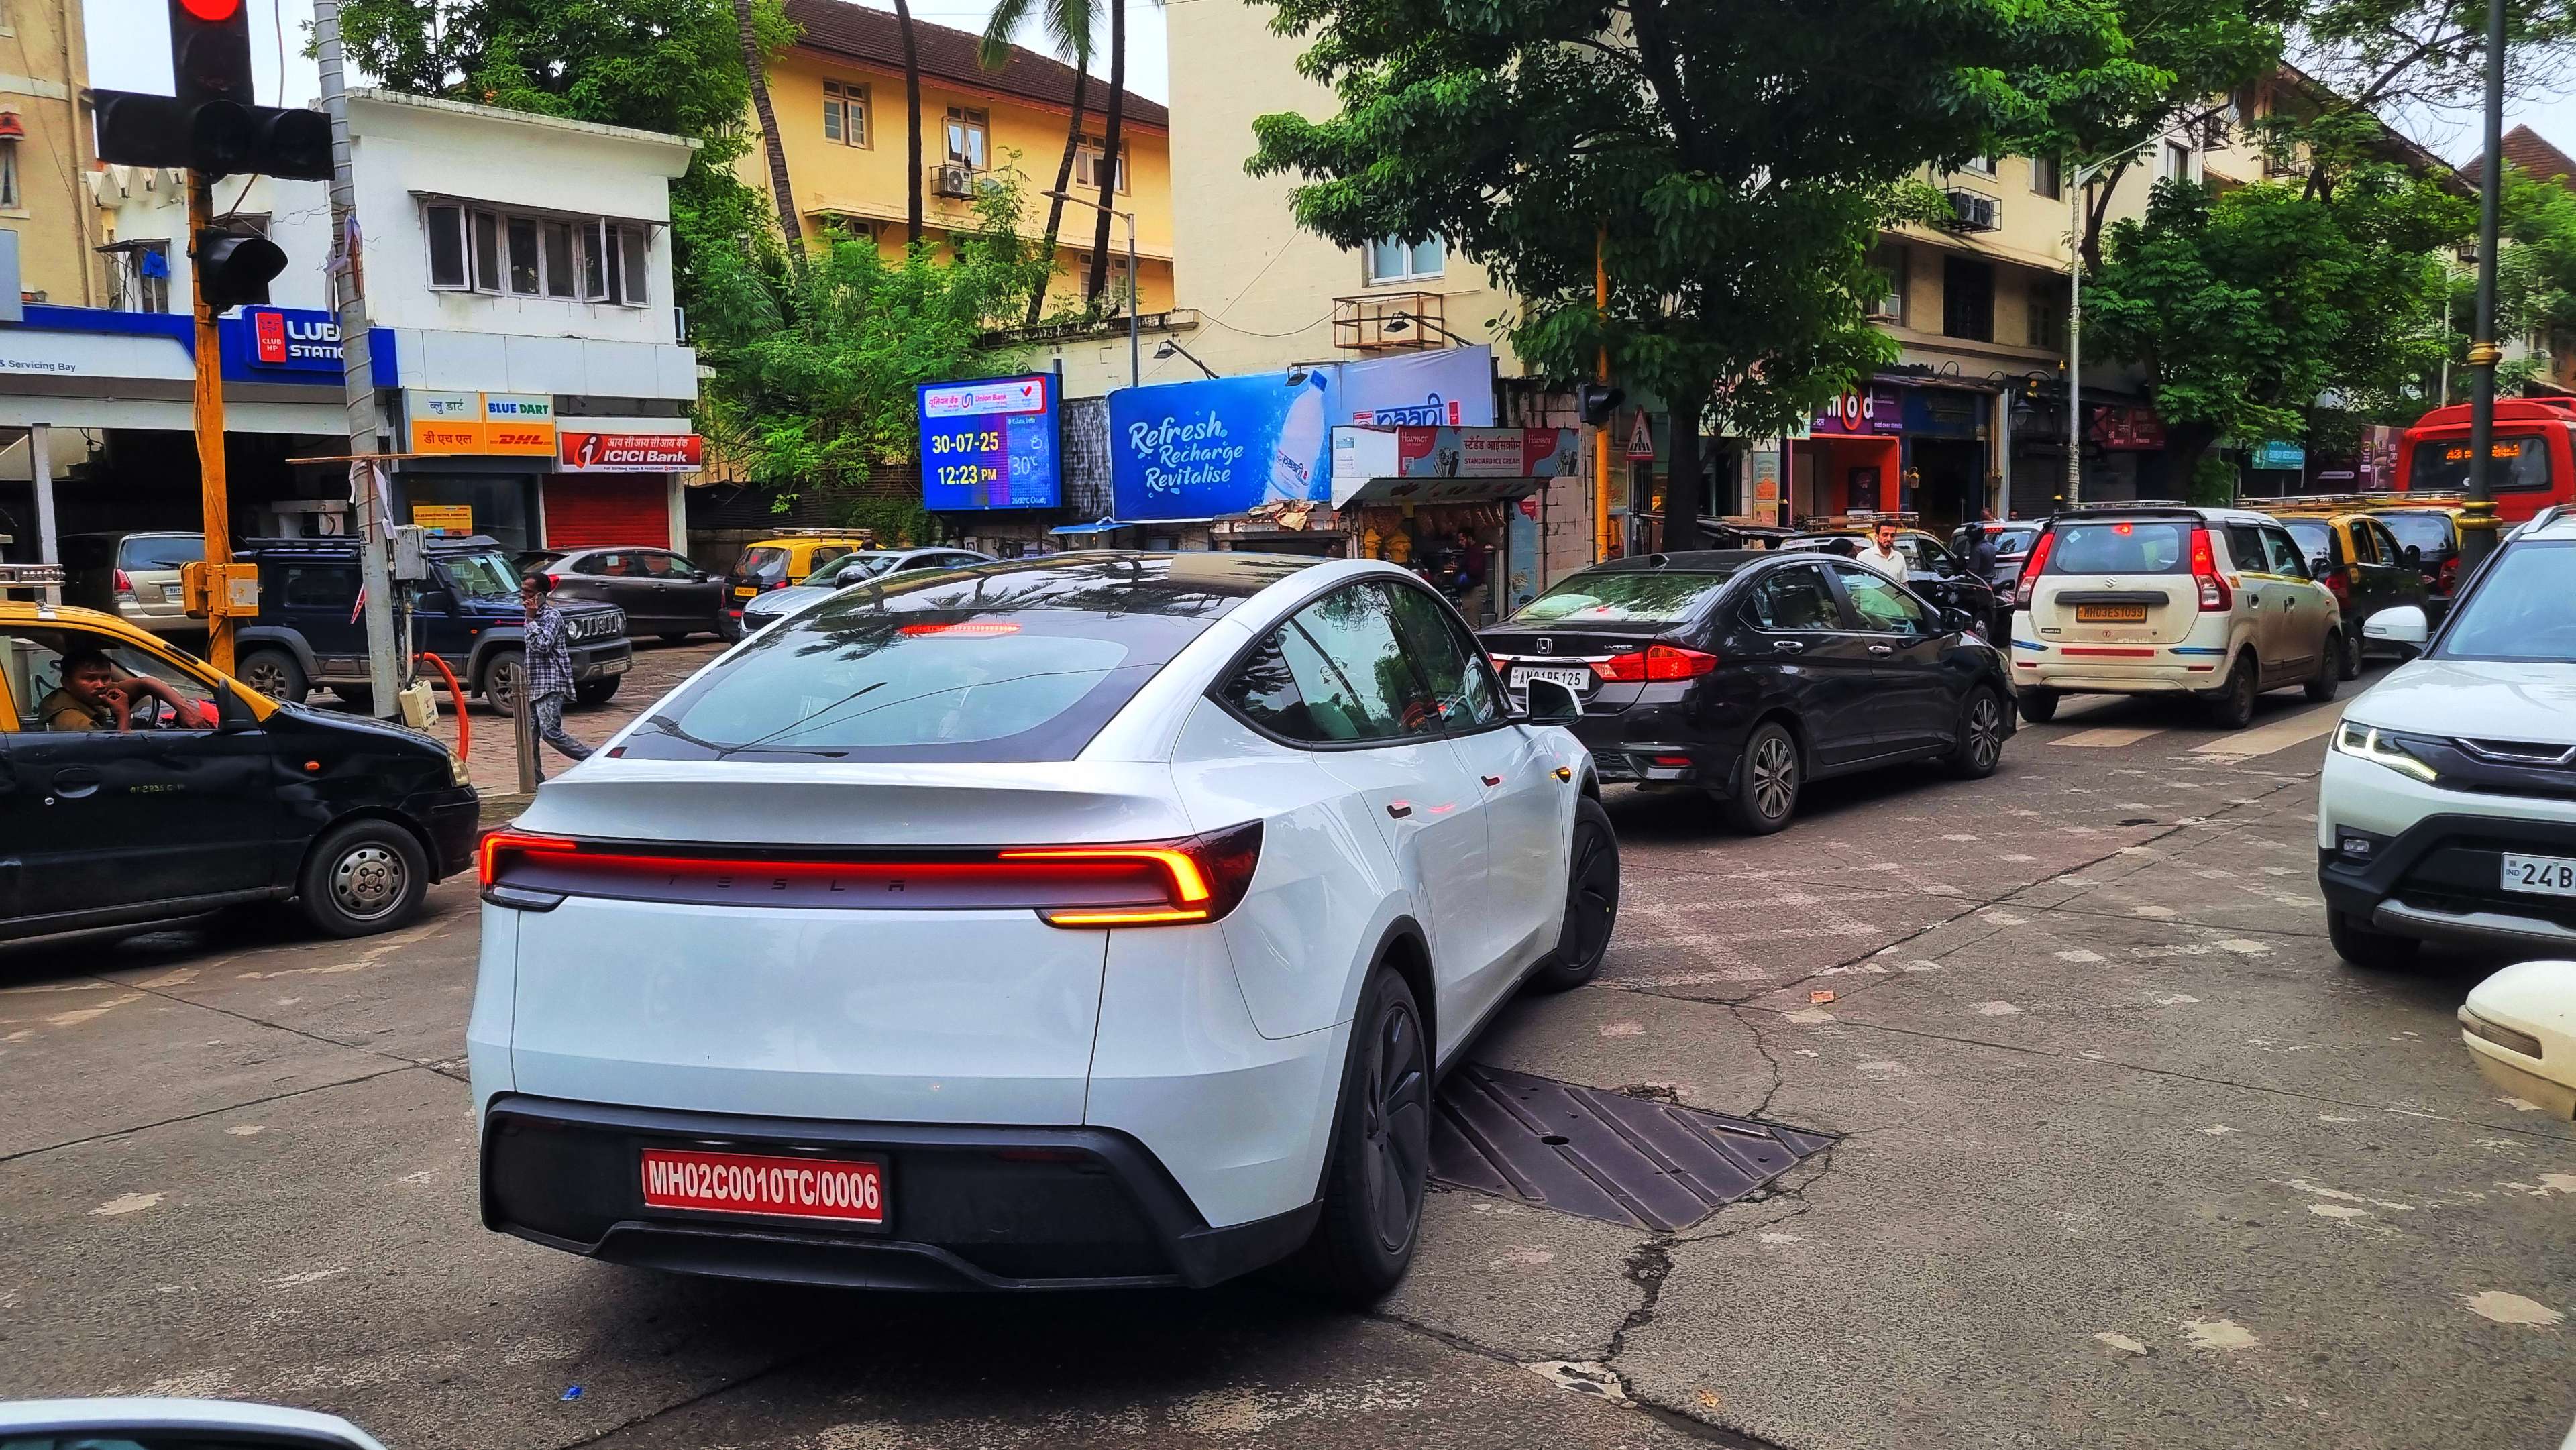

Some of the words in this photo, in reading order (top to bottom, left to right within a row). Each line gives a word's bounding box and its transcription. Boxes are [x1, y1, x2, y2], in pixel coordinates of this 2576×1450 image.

[286, 321, 342, 342] LUB
[8, 359, 55, 372] Servicing
[58, 363, 76, 372] Bay
[445, 399, 464, 411] डार्ट
[488, 402, 517, 413] BLUE
[519, 404, 549, 414] DART
[423, 430, 435, 444] डी
[437, 434, 453, 445] एच
[455, 435, 472, 445] एल
[498, 435, 543, 445] DHL
[932, 431, 999, 454] 30-07-25
[604, 450, 644, 462] ICICI
[646, 451, 688, 463] Bank
[1159, 443, 1244, 468] Recharge
[937, 465, 978, 484] 12:23
[981, 469, 997, 481] PM
[1145, 463, 1231, 492] Revitalise
[668, 873, 906, 893] TESLA
[649, 1160, 879, 1209] MH02C0010TC/0006
